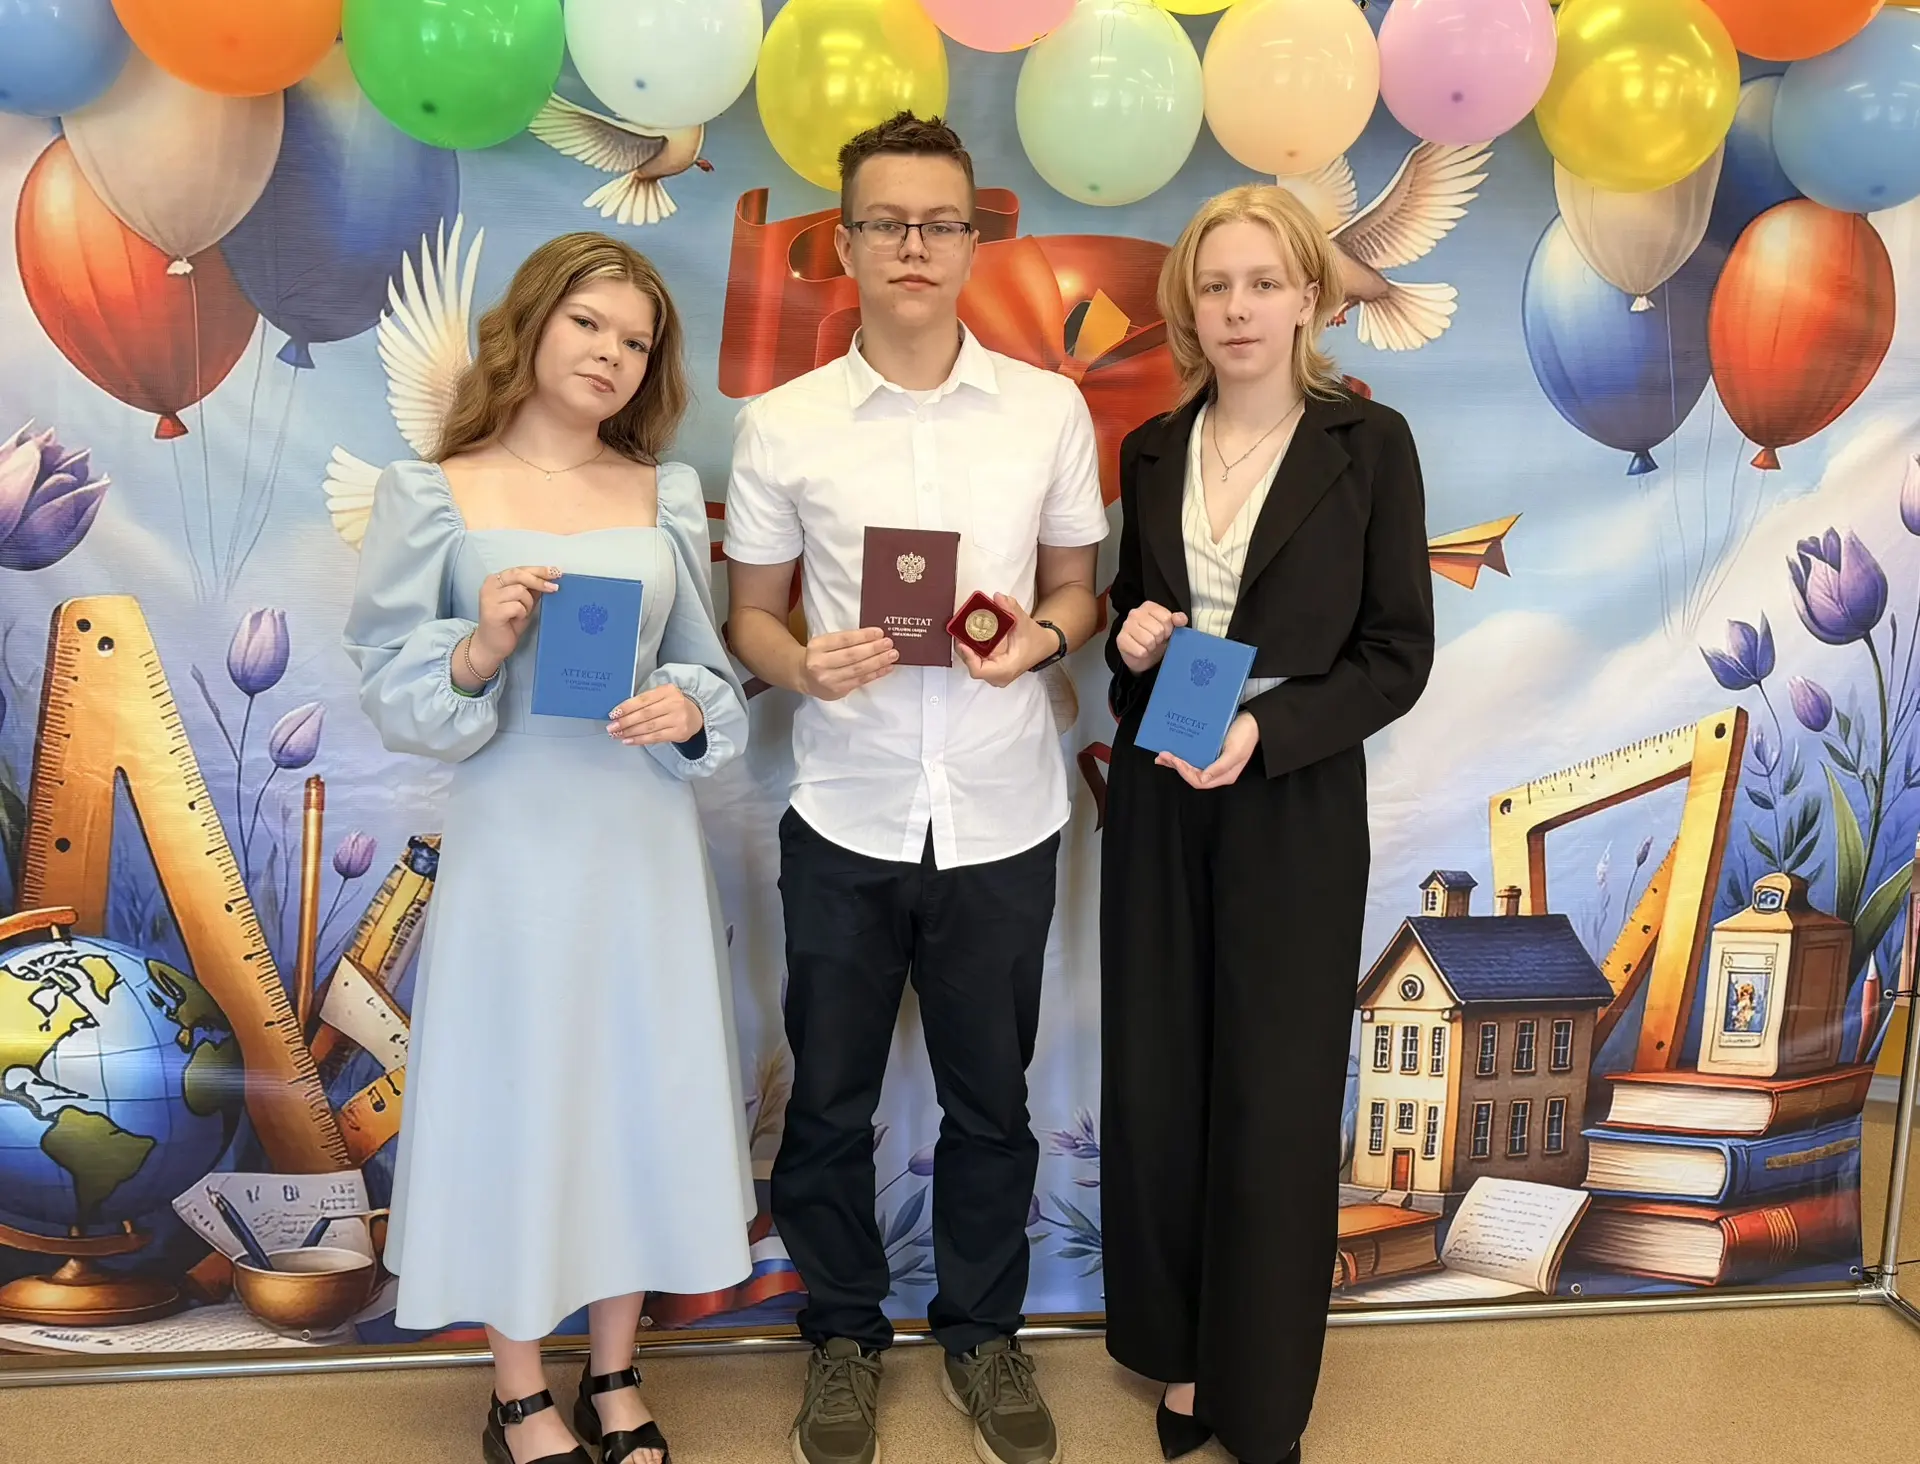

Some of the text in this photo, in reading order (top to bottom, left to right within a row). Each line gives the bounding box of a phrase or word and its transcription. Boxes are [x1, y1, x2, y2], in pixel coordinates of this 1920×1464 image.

[884, 616, 933, 626] АТТЕСТАТ
[561, 668, 613, 681] АТТЕСТАТ
[1164, 710, 1208, 730] АТТЕСТАТ
